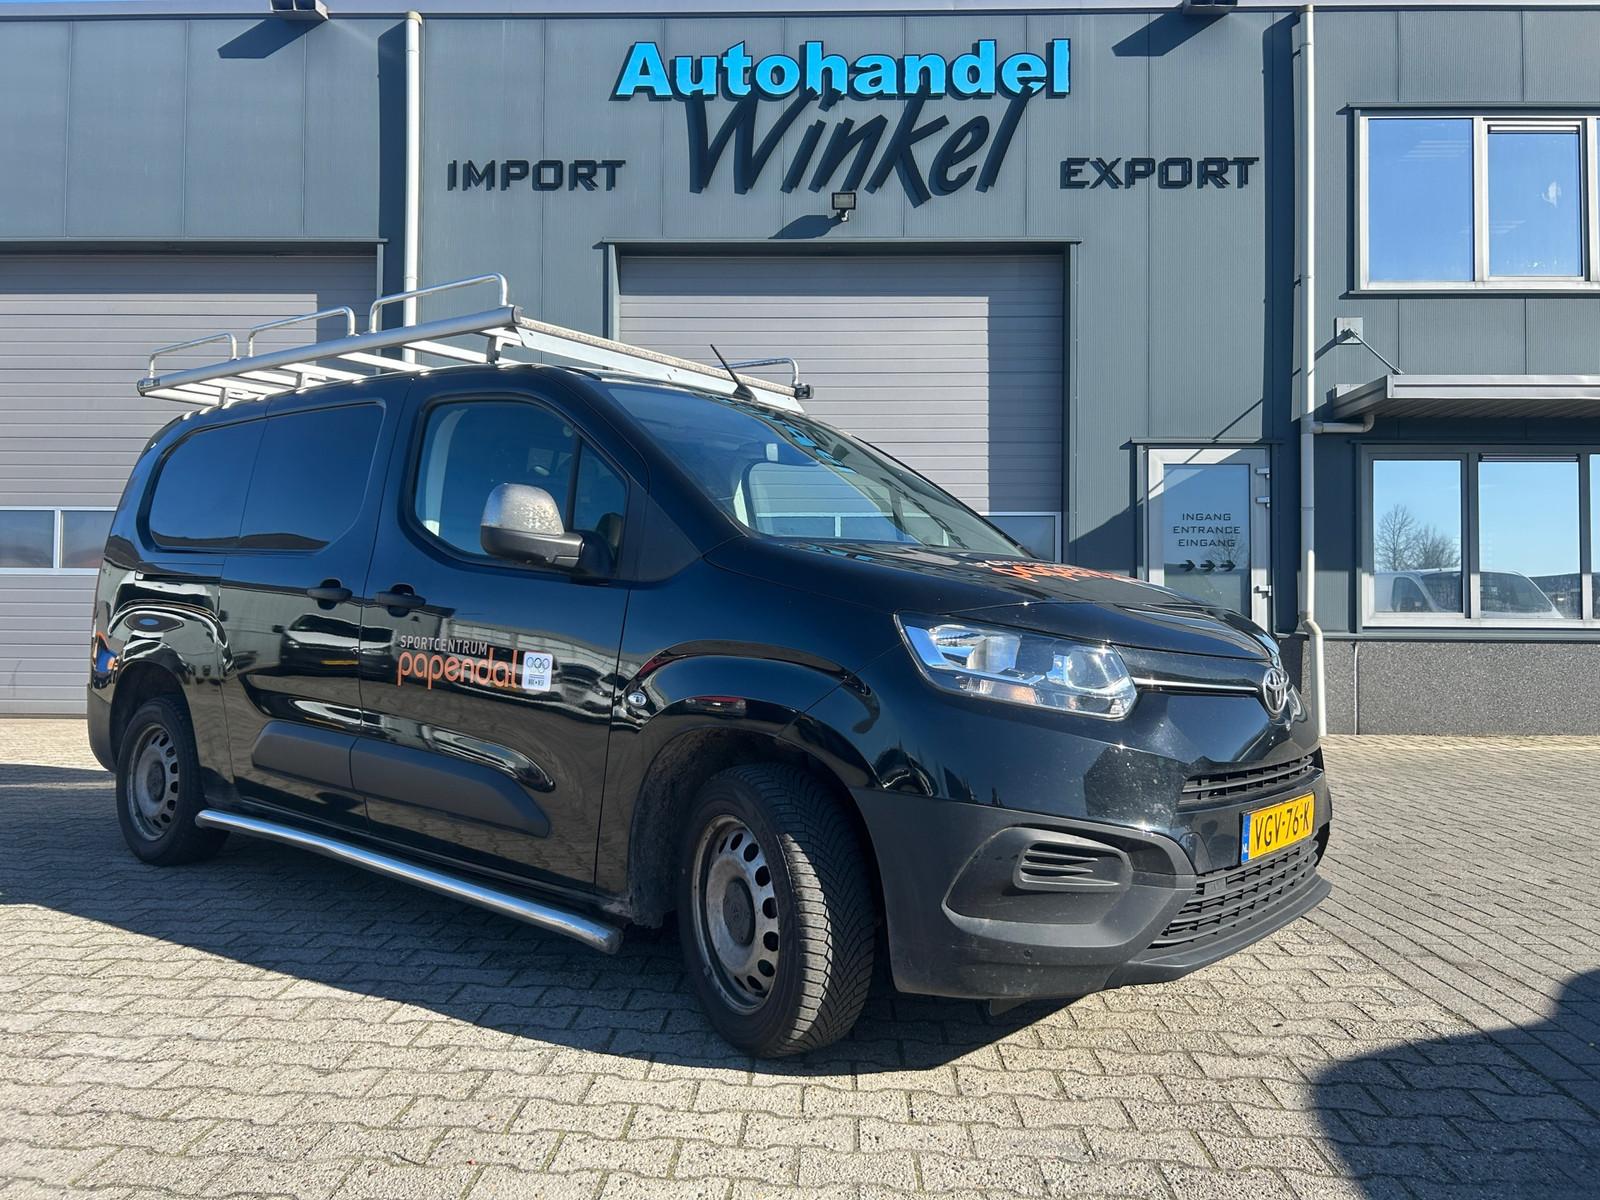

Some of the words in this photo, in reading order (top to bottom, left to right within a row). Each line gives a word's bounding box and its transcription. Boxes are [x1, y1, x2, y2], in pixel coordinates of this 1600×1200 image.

[614, 38, 1071, 98] Autohandel
[685, 83, 1034, 208] Winkel
[447, 159, 627, 192] IMPORT
[1059, 156, 1260, 190] EXPORT
[1172, 525, 1241, 535] ENTRANCE
[1181, 512, 1232, 521] INGANG
[1177, 538, 1236, 548] EINGANG
[399, 634, 489, 656] SPORTCENTRUM
[396, 646, 518, 691] papendal
[1254, 800, 1311, 851] VGV-76-K
